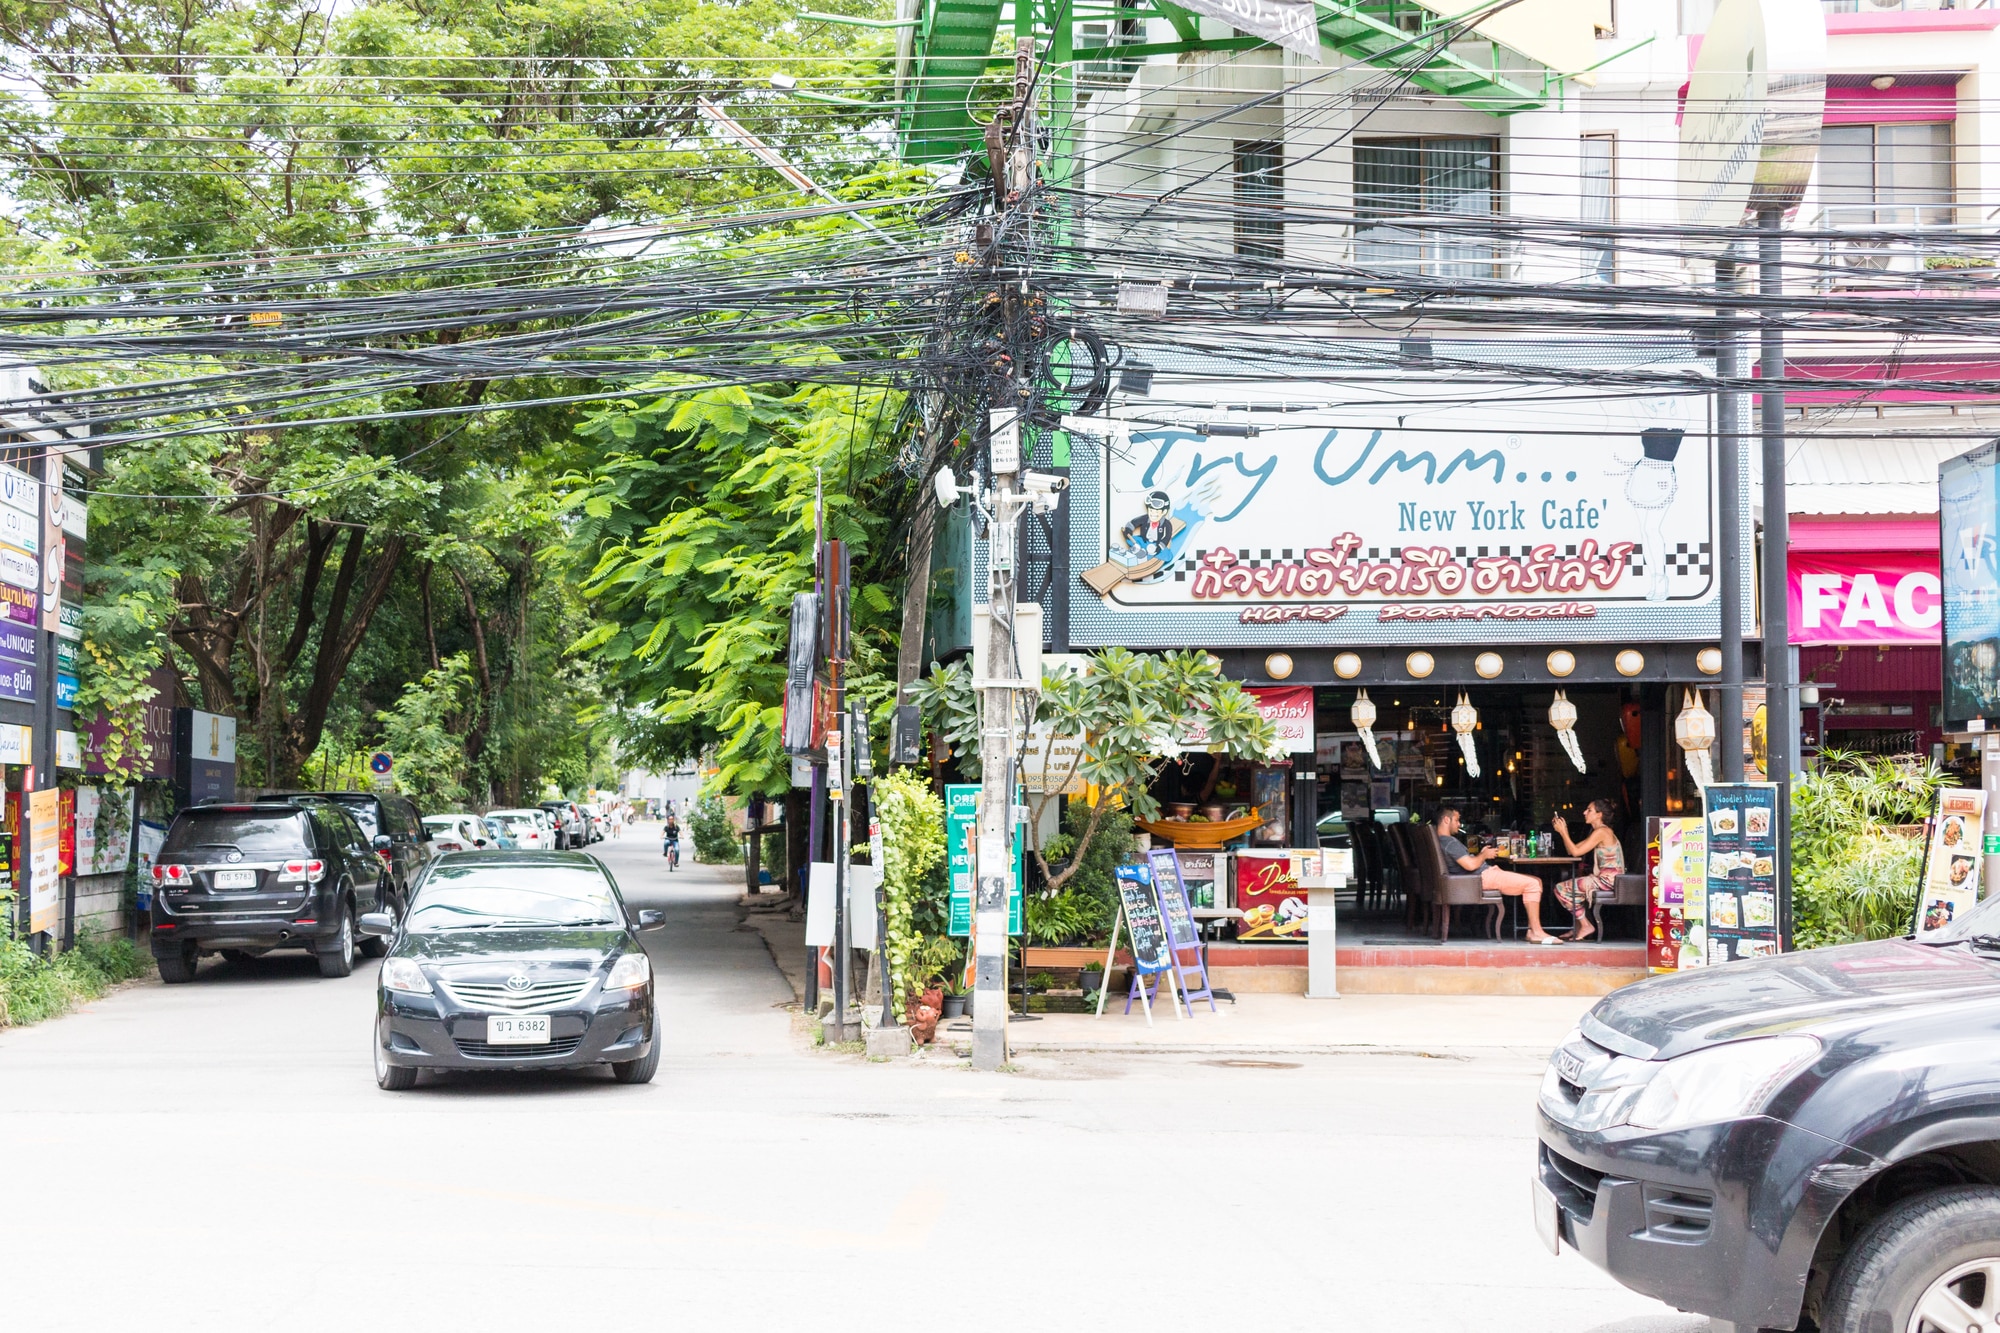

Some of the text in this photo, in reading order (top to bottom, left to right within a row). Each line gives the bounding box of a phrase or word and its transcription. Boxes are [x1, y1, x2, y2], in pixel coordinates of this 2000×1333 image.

[1128, 428, 1578, 523] Try Umm...
[1398, 500, 1457, 533] New
[1466, 500, 1526, 531] York
[6, 633, 35, 655] UNIQUE
[496, 1020, 546, 1032] ขว 6382
